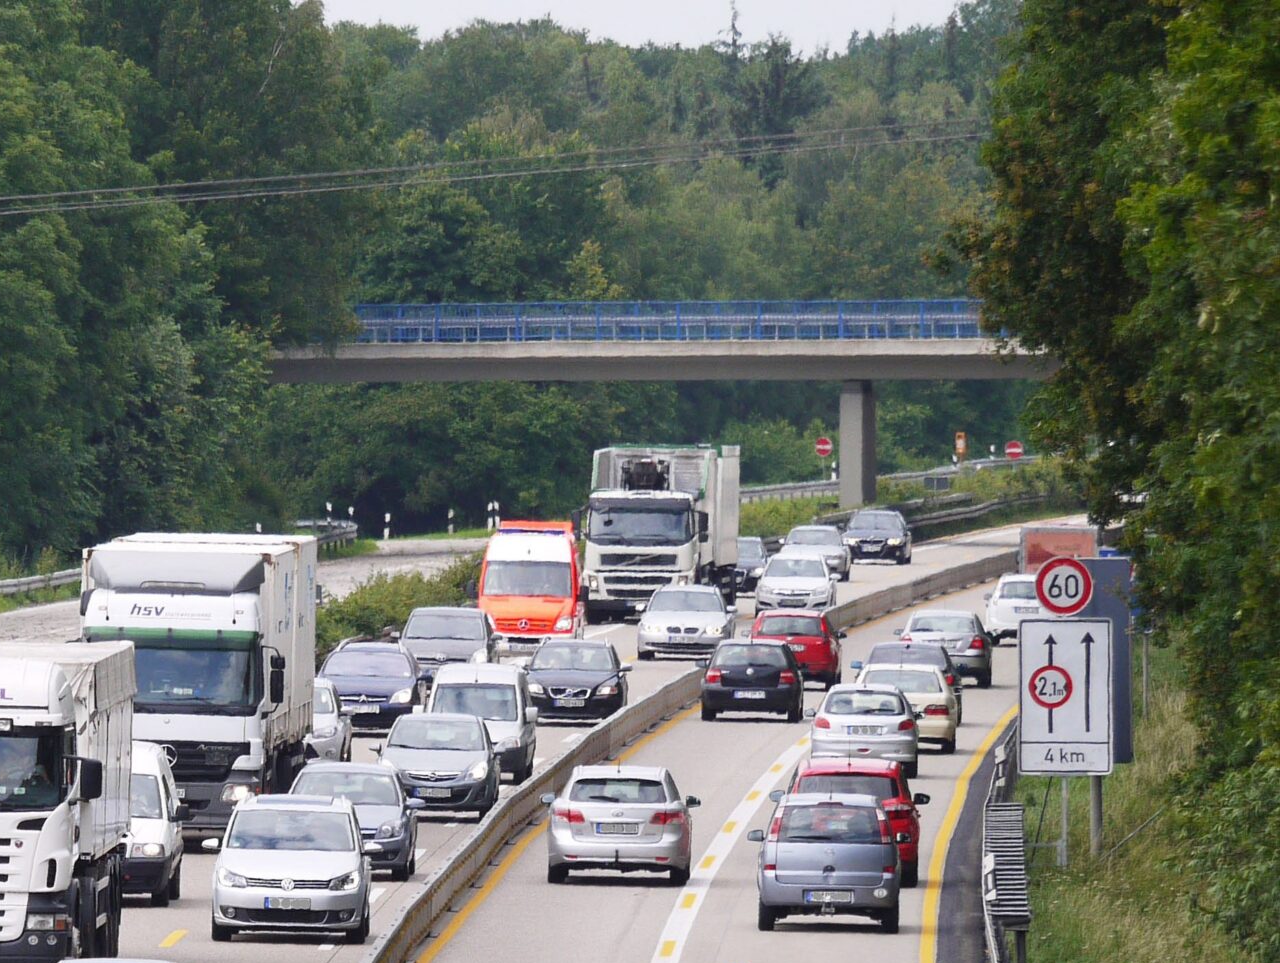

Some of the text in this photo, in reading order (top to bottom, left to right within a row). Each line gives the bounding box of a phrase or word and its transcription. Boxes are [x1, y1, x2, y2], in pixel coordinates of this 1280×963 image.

[1048, 574, 1079, 599] 60
[130, 603, 165, 616] hsv
[1044, 748, 1085, 763] 4 km
